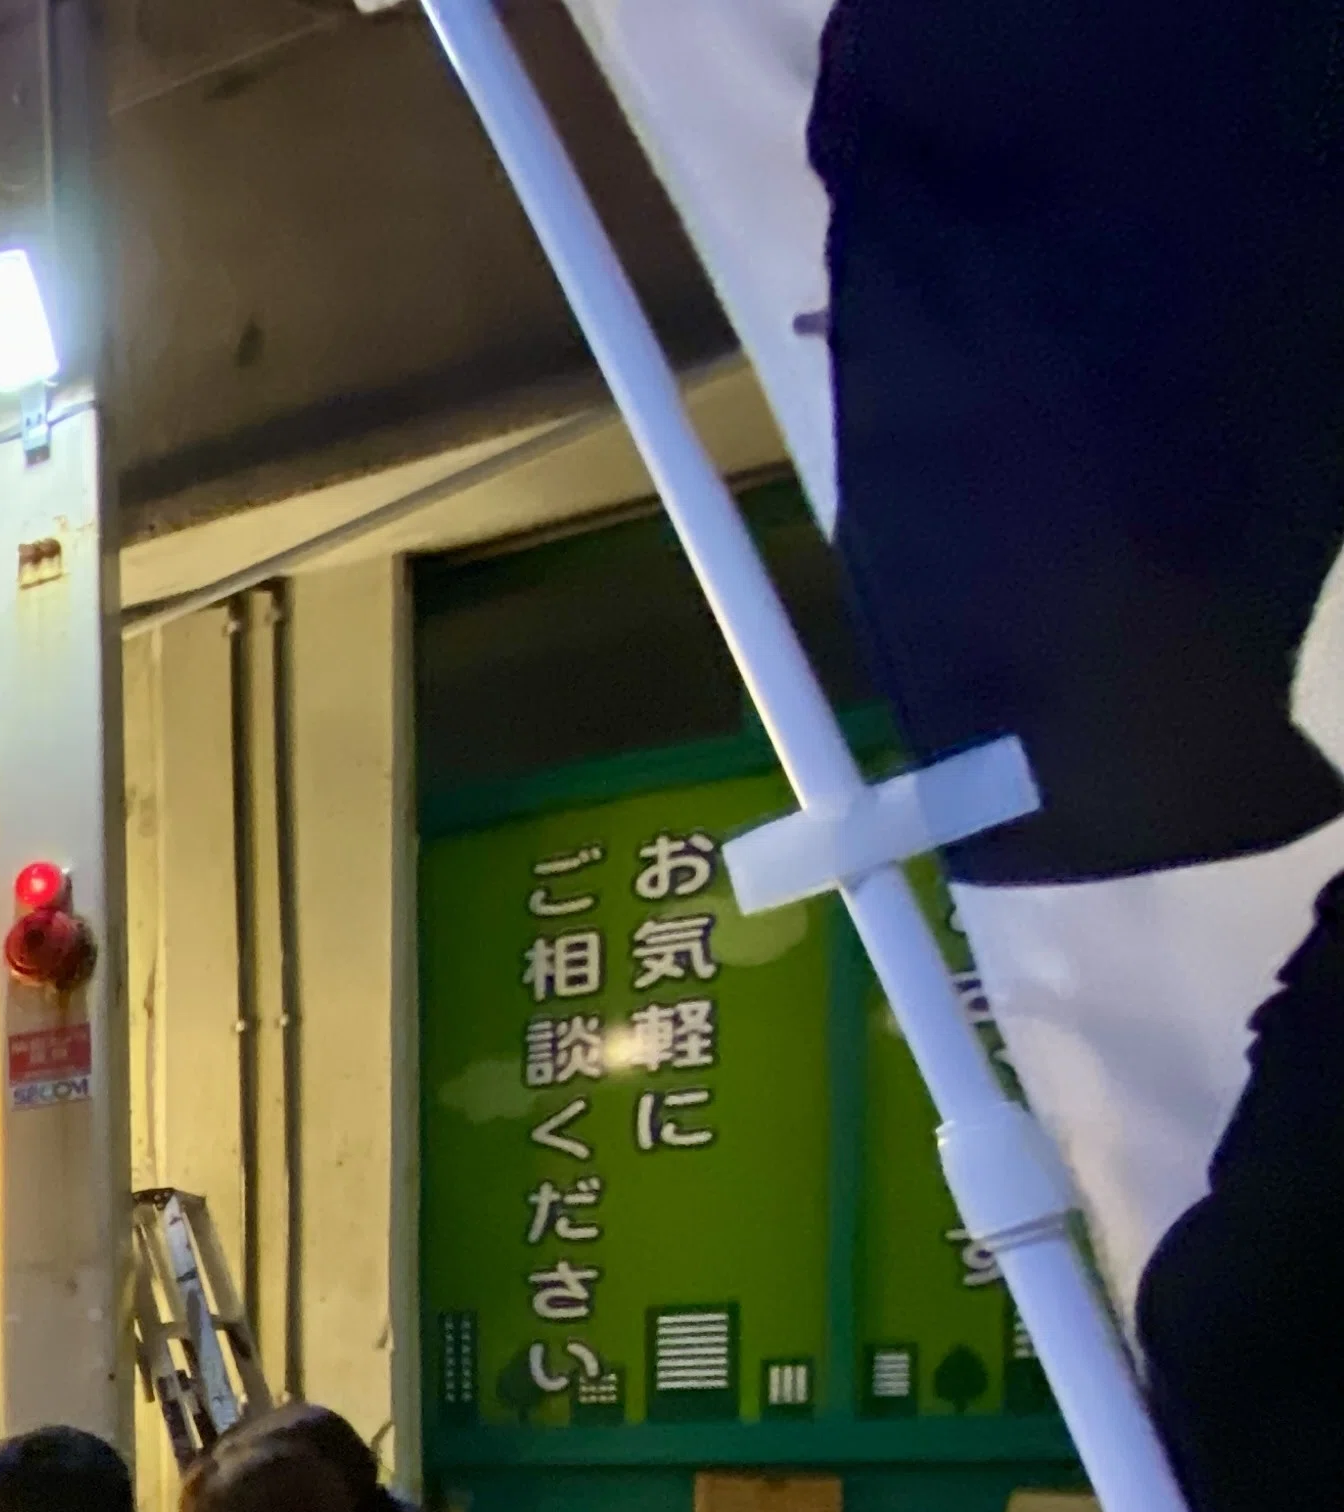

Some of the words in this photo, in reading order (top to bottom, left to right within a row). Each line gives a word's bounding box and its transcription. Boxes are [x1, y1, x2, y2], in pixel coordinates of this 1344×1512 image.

[524, 843, 602, 1391] ご相談ください
[633, 831, 716, 1150] お気軽に
